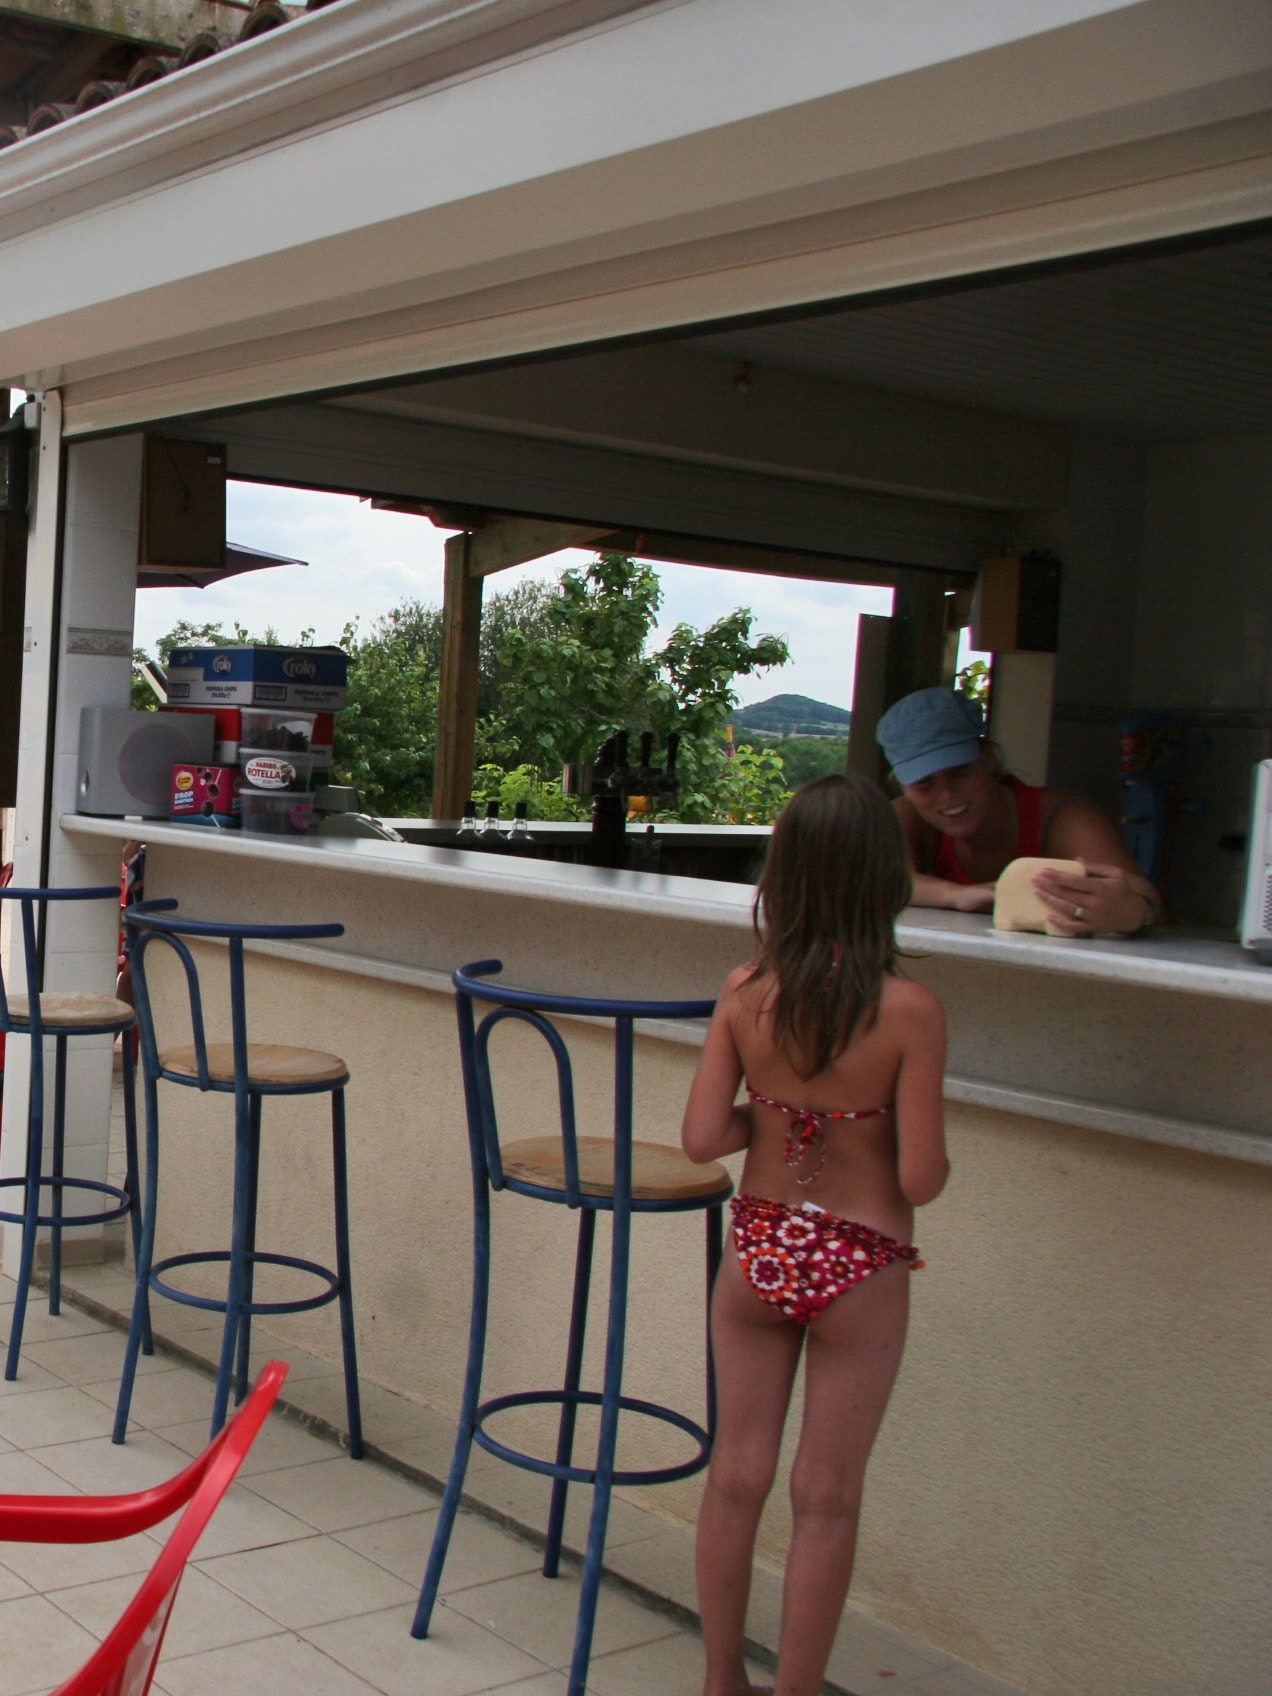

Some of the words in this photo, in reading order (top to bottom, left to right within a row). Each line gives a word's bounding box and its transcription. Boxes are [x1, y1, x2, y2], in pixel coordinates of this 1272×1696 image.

[282, 657, 318, 679] Croky
[255, 761, 277, 769] HARIBO
[247, 767, 281, 779] ROTELLA
